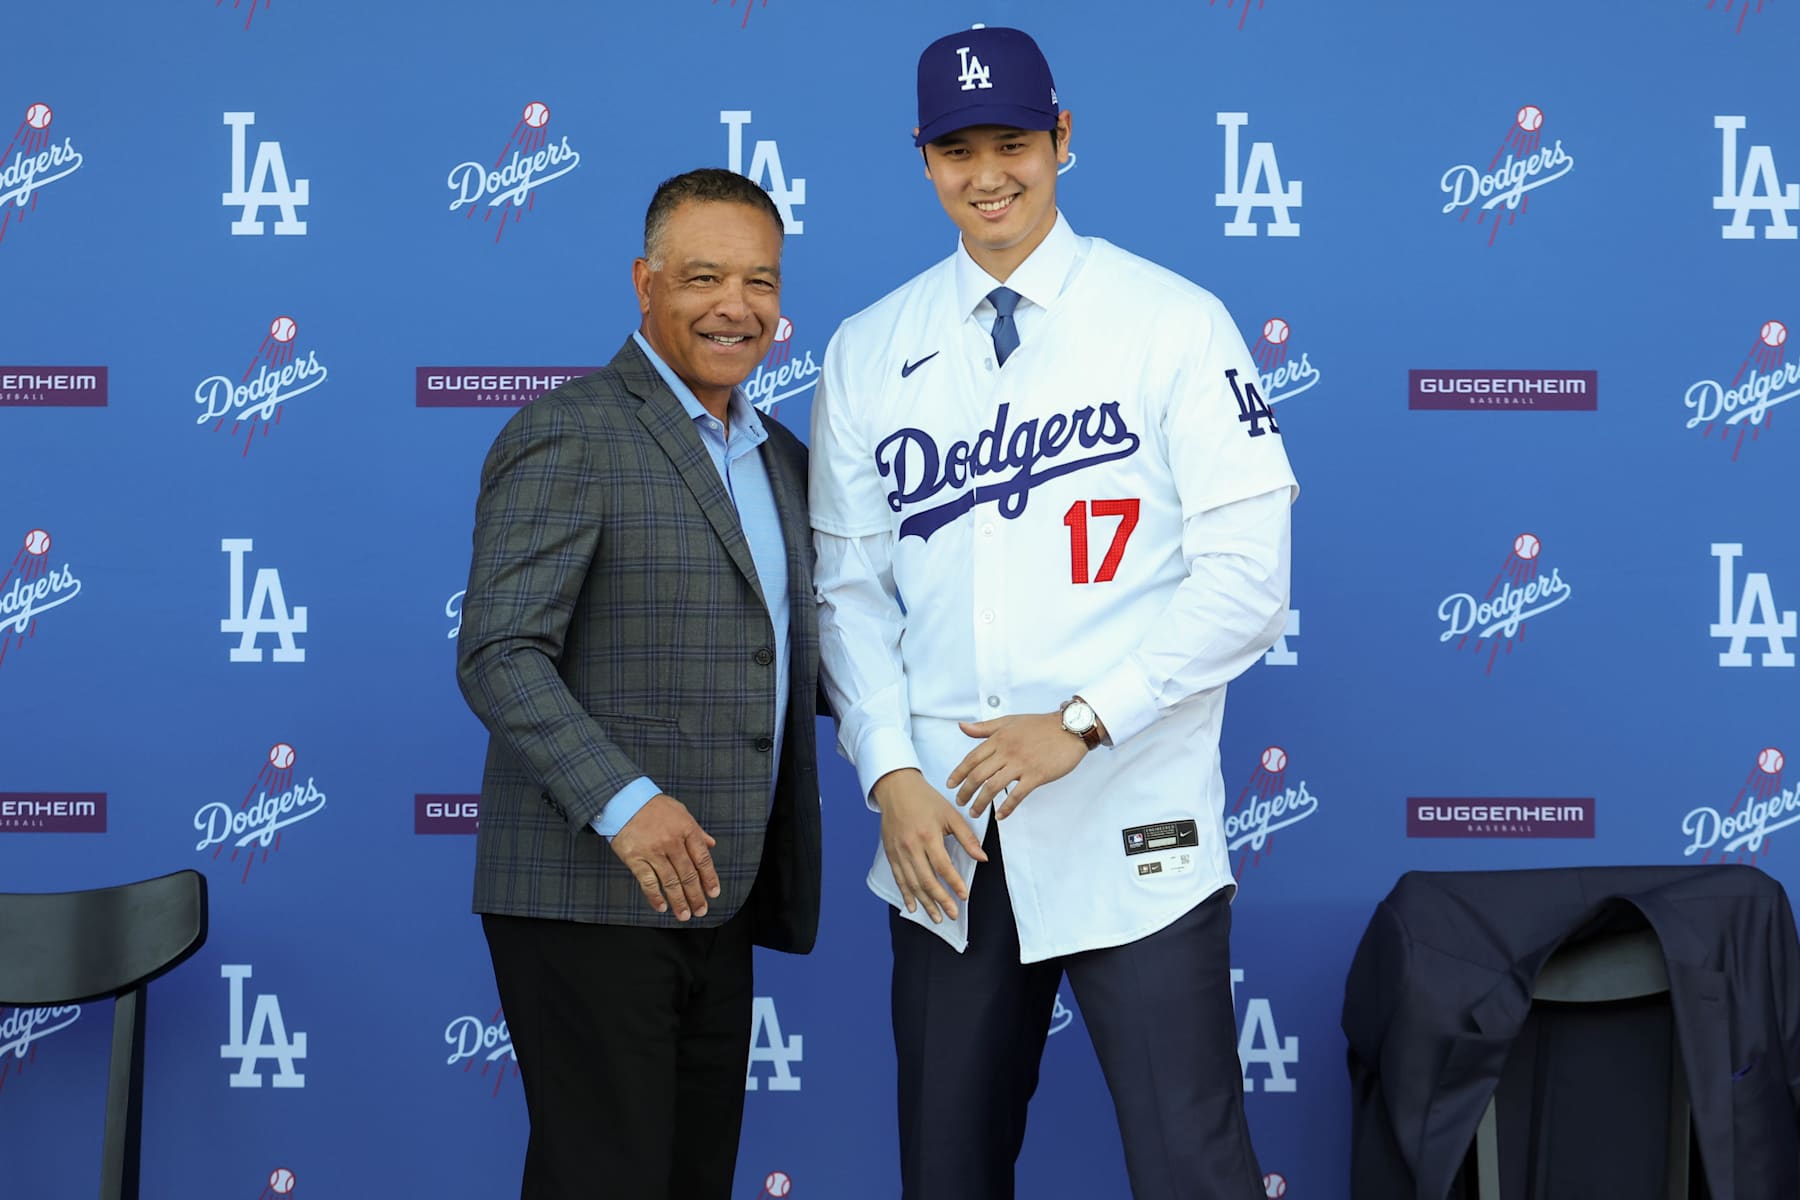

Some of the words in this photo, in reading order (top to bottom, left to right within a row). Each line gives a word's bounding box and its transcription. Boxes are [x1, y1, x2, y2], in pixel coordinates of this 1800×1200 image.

[956, 46, 993, 91] LA
[222, 111, 310, 236] LA
[447, 135, 580, 211] Dodgers
[1215, 111, 1303, 237] LA
[1440, 139, 1574, 214] Dodgers
[1713, 115, 1800, 240] LA
[194, 350, 328, 425] Dodgers
[427, 375, 583, 391] GUGGENHE
[744, 350, 822, 416] dgers
[1420, 378, 1586, 394] GUGGENHEIM
[1469, 397, 1535, 405] BASEBALL
[1684, 356, 1800, 429] Dodger
[875, 400, 1140, 543] Dodgers
[1063, 498, 1140, 584] 17
[0, 563, 82, 634] dgers
[220, 538, 308, 663] LA
[1438, 567, 1571, 642] Dodgers
[1710, 542, 1797, 667] LA
[193, 777, 326, 851] Dodgers
[1225, 780, 1318, 851] odgers
[1418, 806, 1584, 821] GUGGENHEIM
[220, 964, 307, 1088] LA
